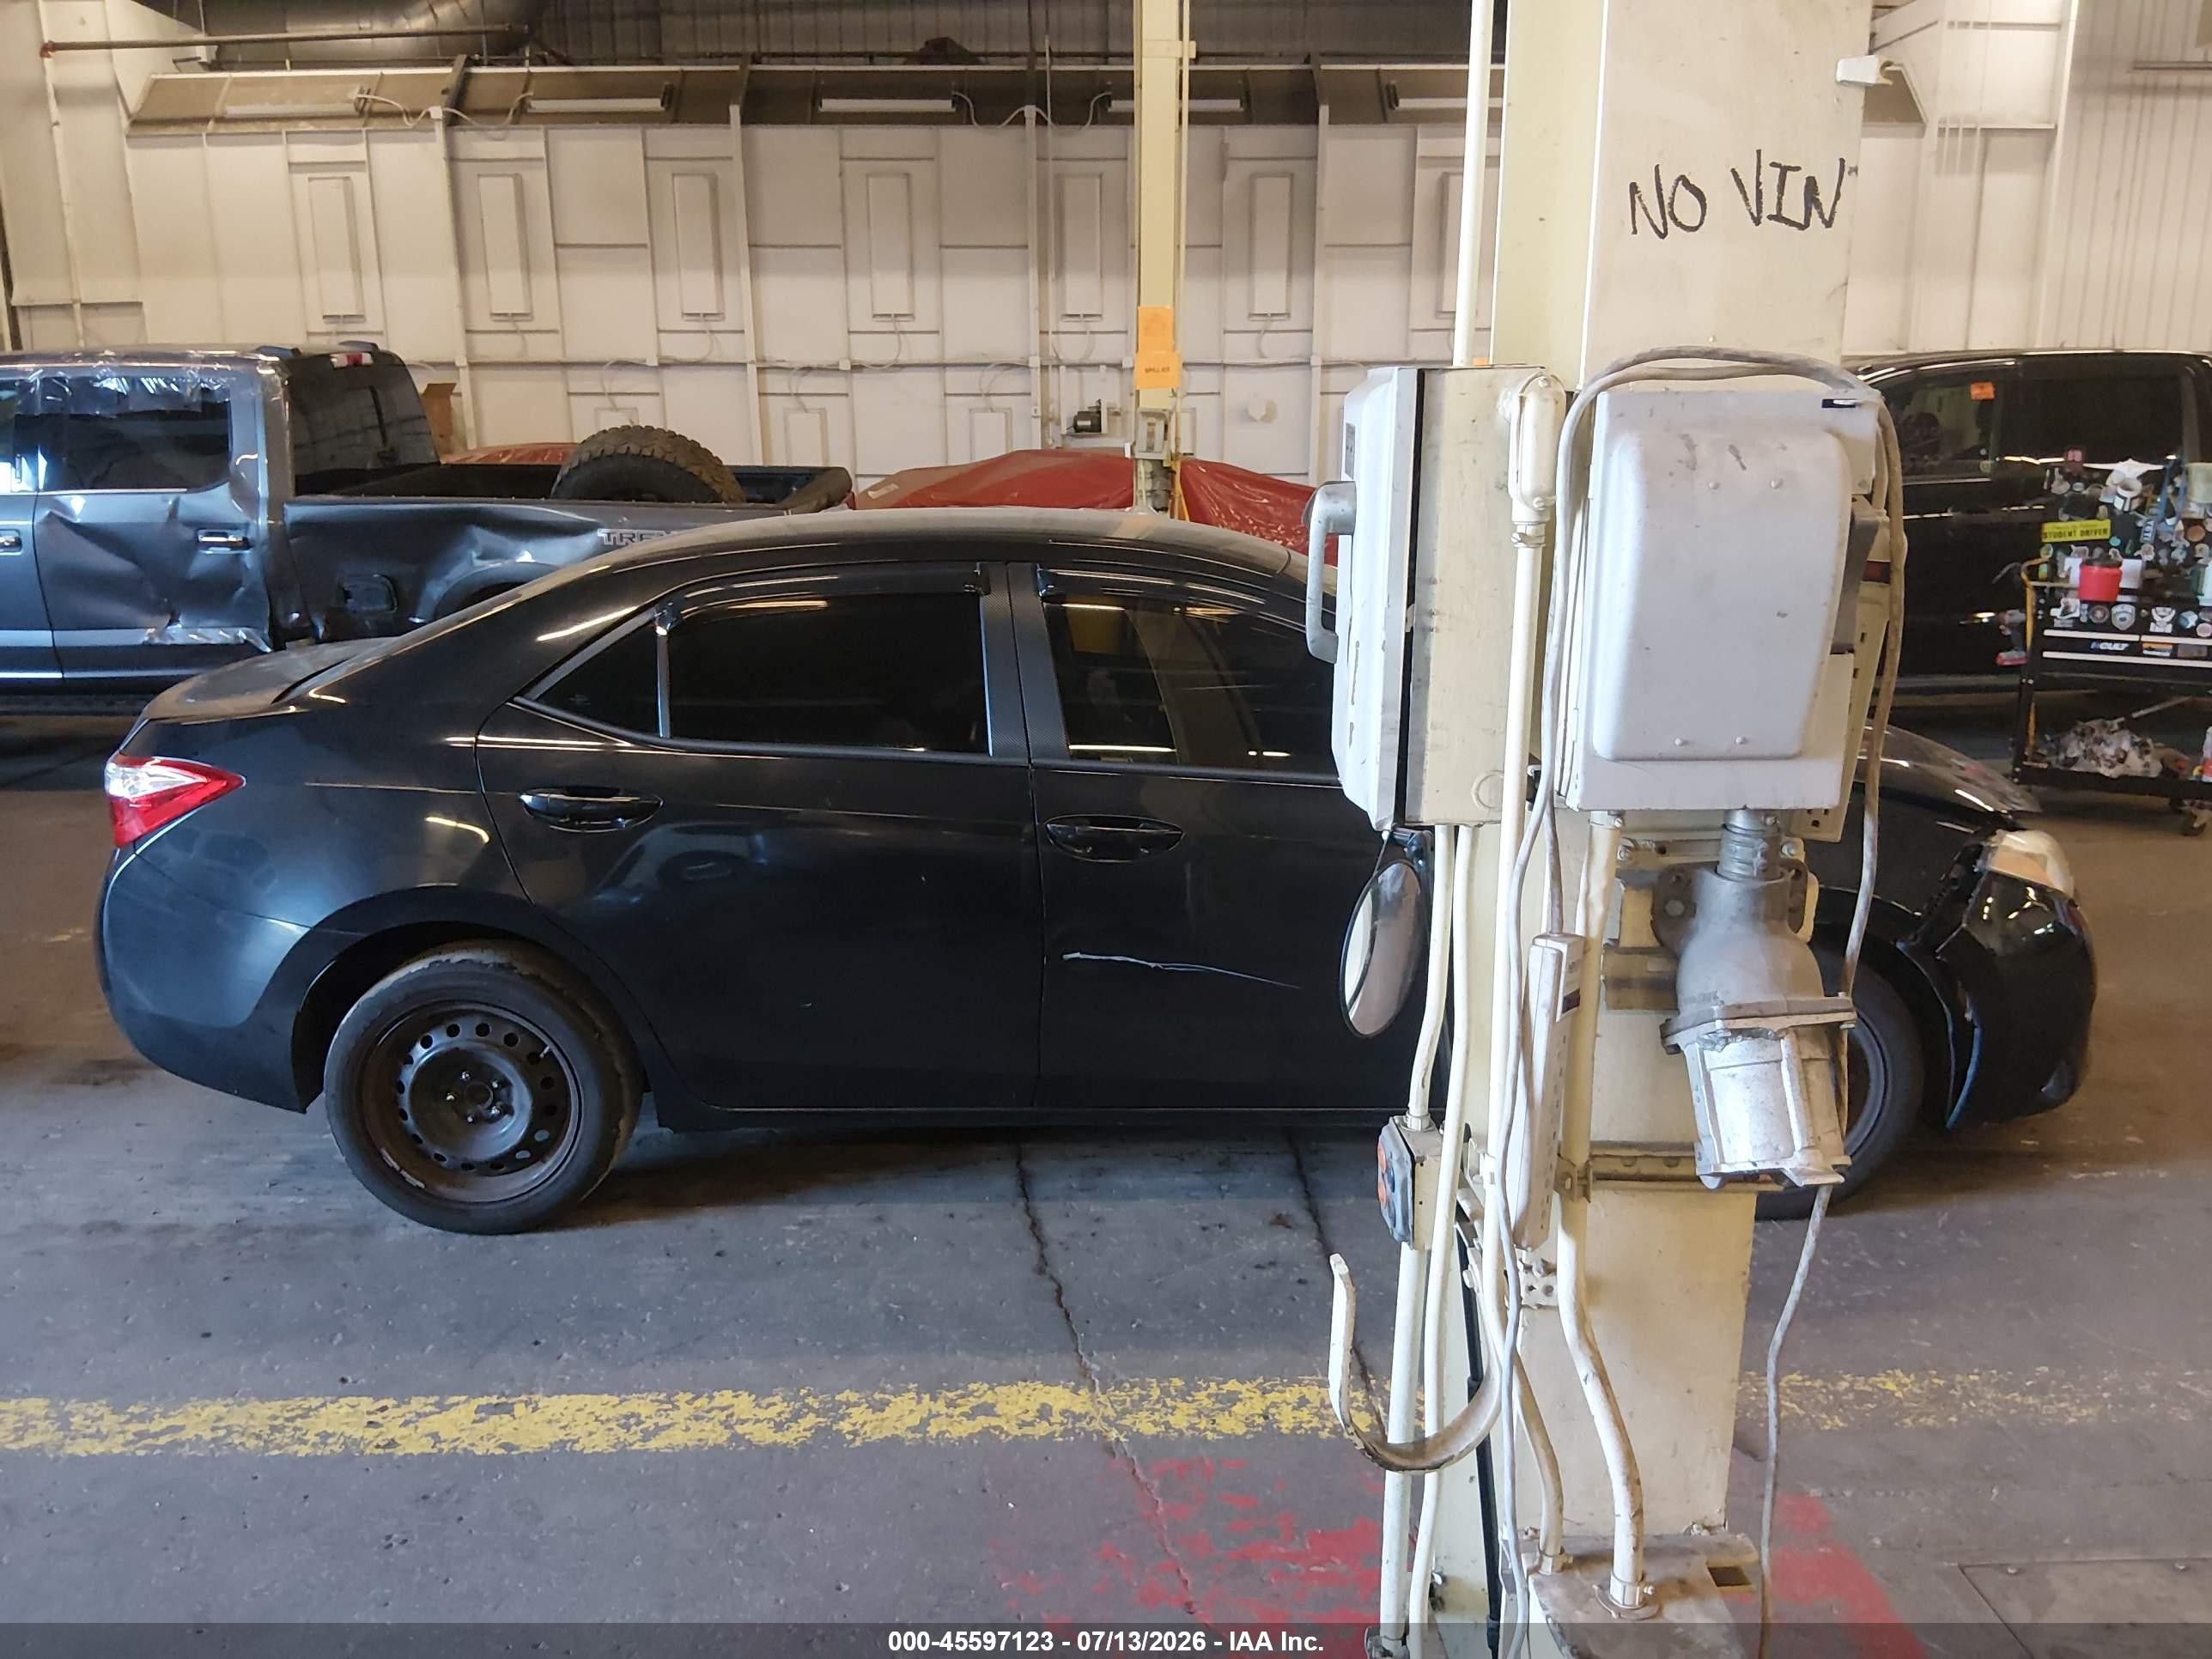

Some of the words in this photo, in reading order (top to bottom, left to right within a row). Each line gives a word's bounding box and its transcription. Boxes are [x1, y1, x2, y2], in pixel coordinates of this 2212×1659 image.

[1629, 163, 1707, 240] NO
[1730, 149, 1845, 231] VIN
[2043, 530, 2077, 539] STUDENT
[2080, 528, 2108, 537] DRIVER
